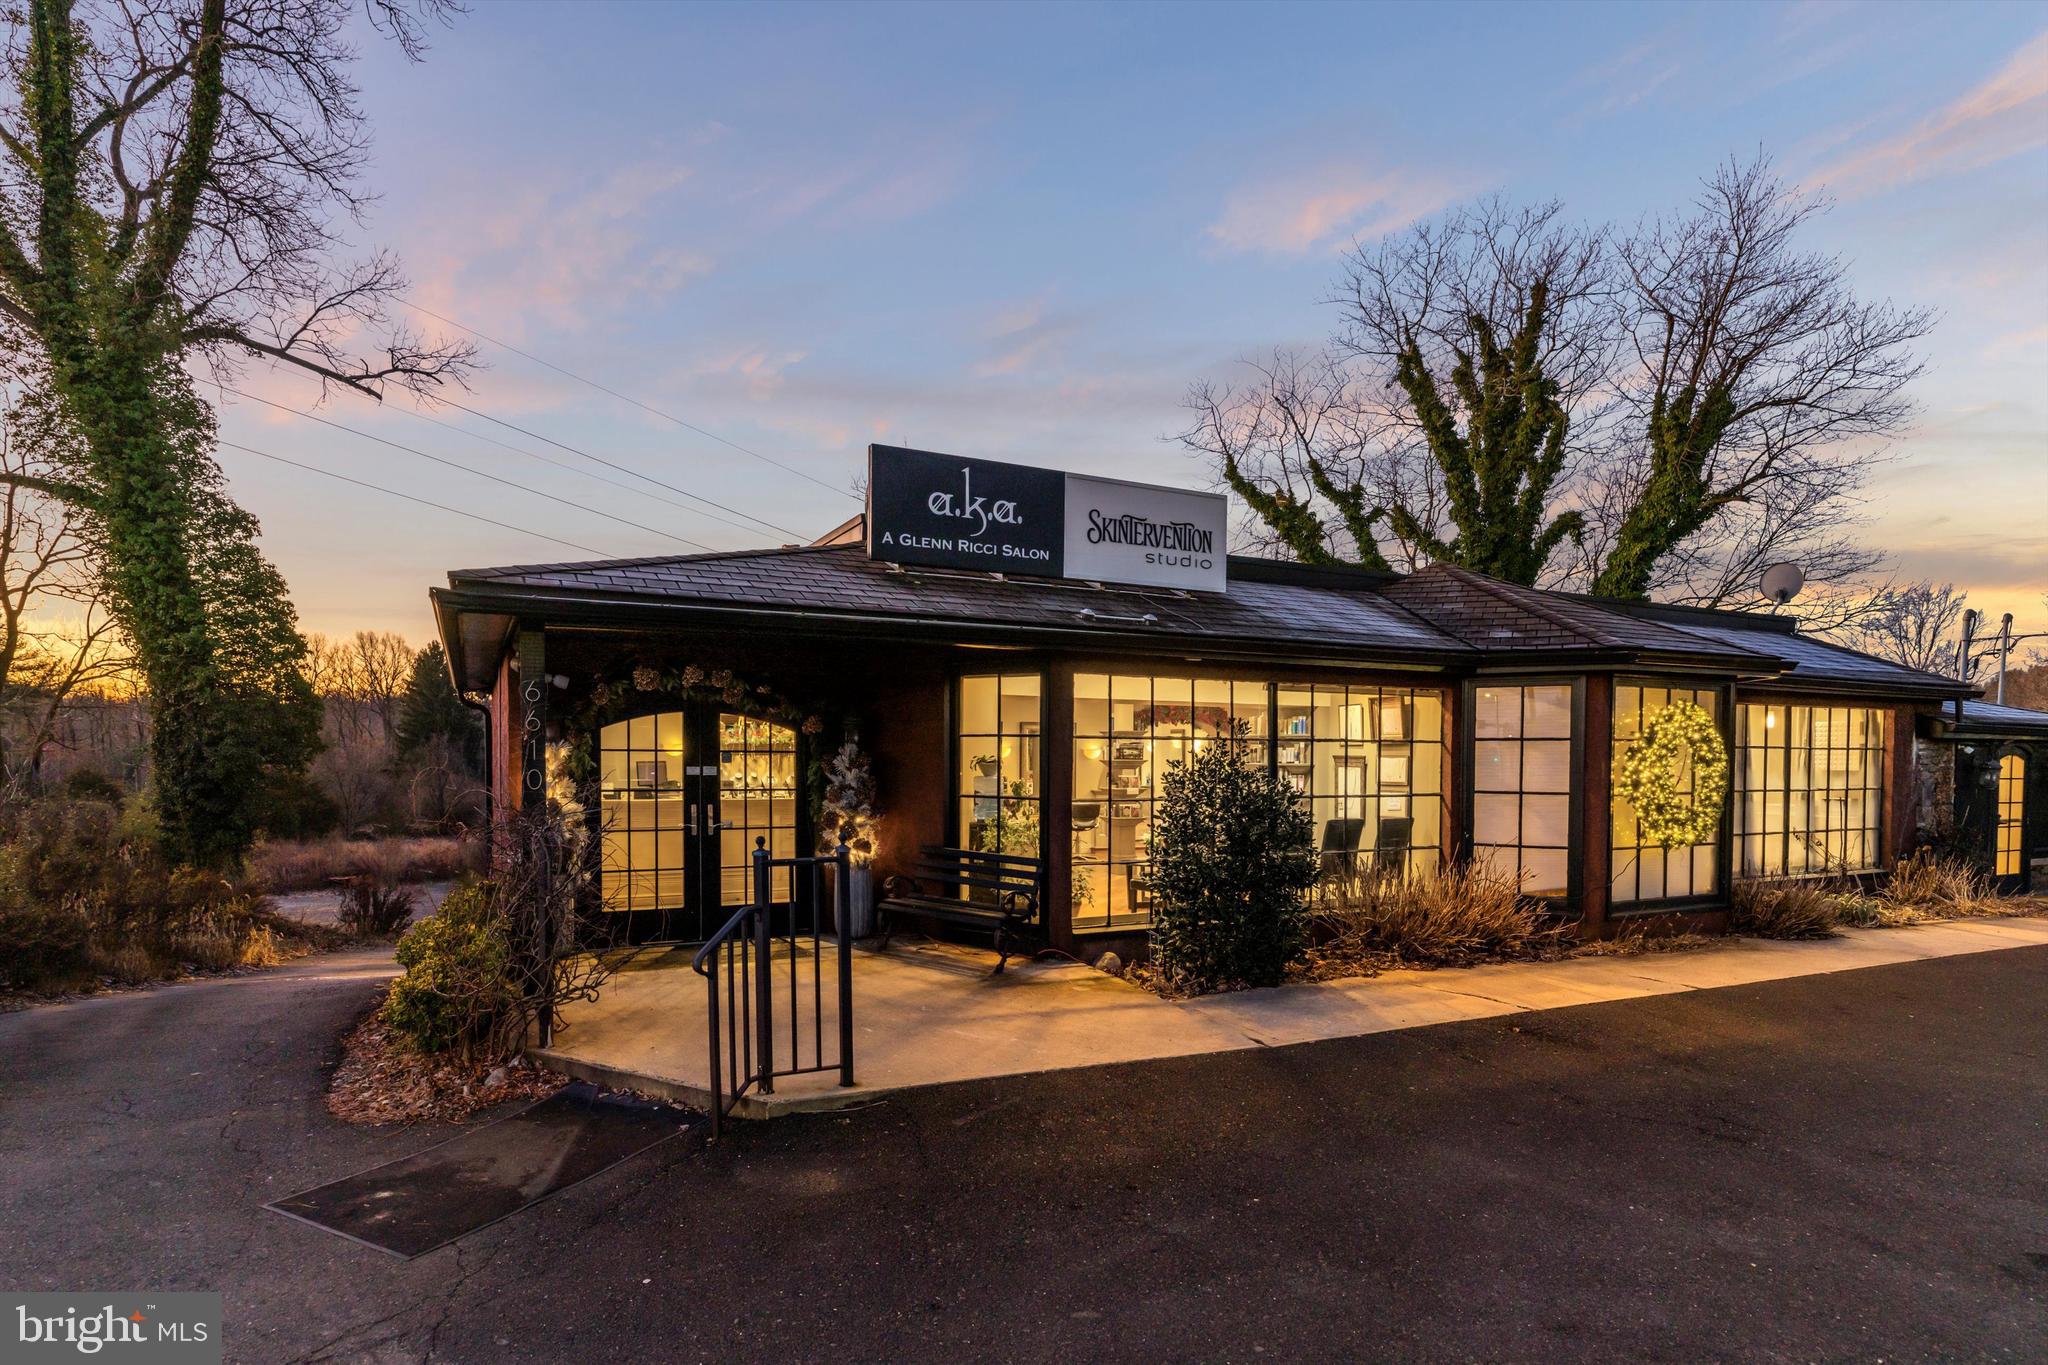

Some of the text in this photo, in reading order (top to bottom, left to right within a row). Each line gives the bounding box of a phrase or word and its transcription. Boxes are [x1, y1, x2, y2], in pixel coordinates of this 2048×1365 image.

[928, 467, 1023, 537] a.k.a.
[882, 531, 1049, 561] A GLENN RICCI SALON
[1087, 509, 1213, 553] SKINTERVENTION
[1145, 552, 1213, 569] studio
